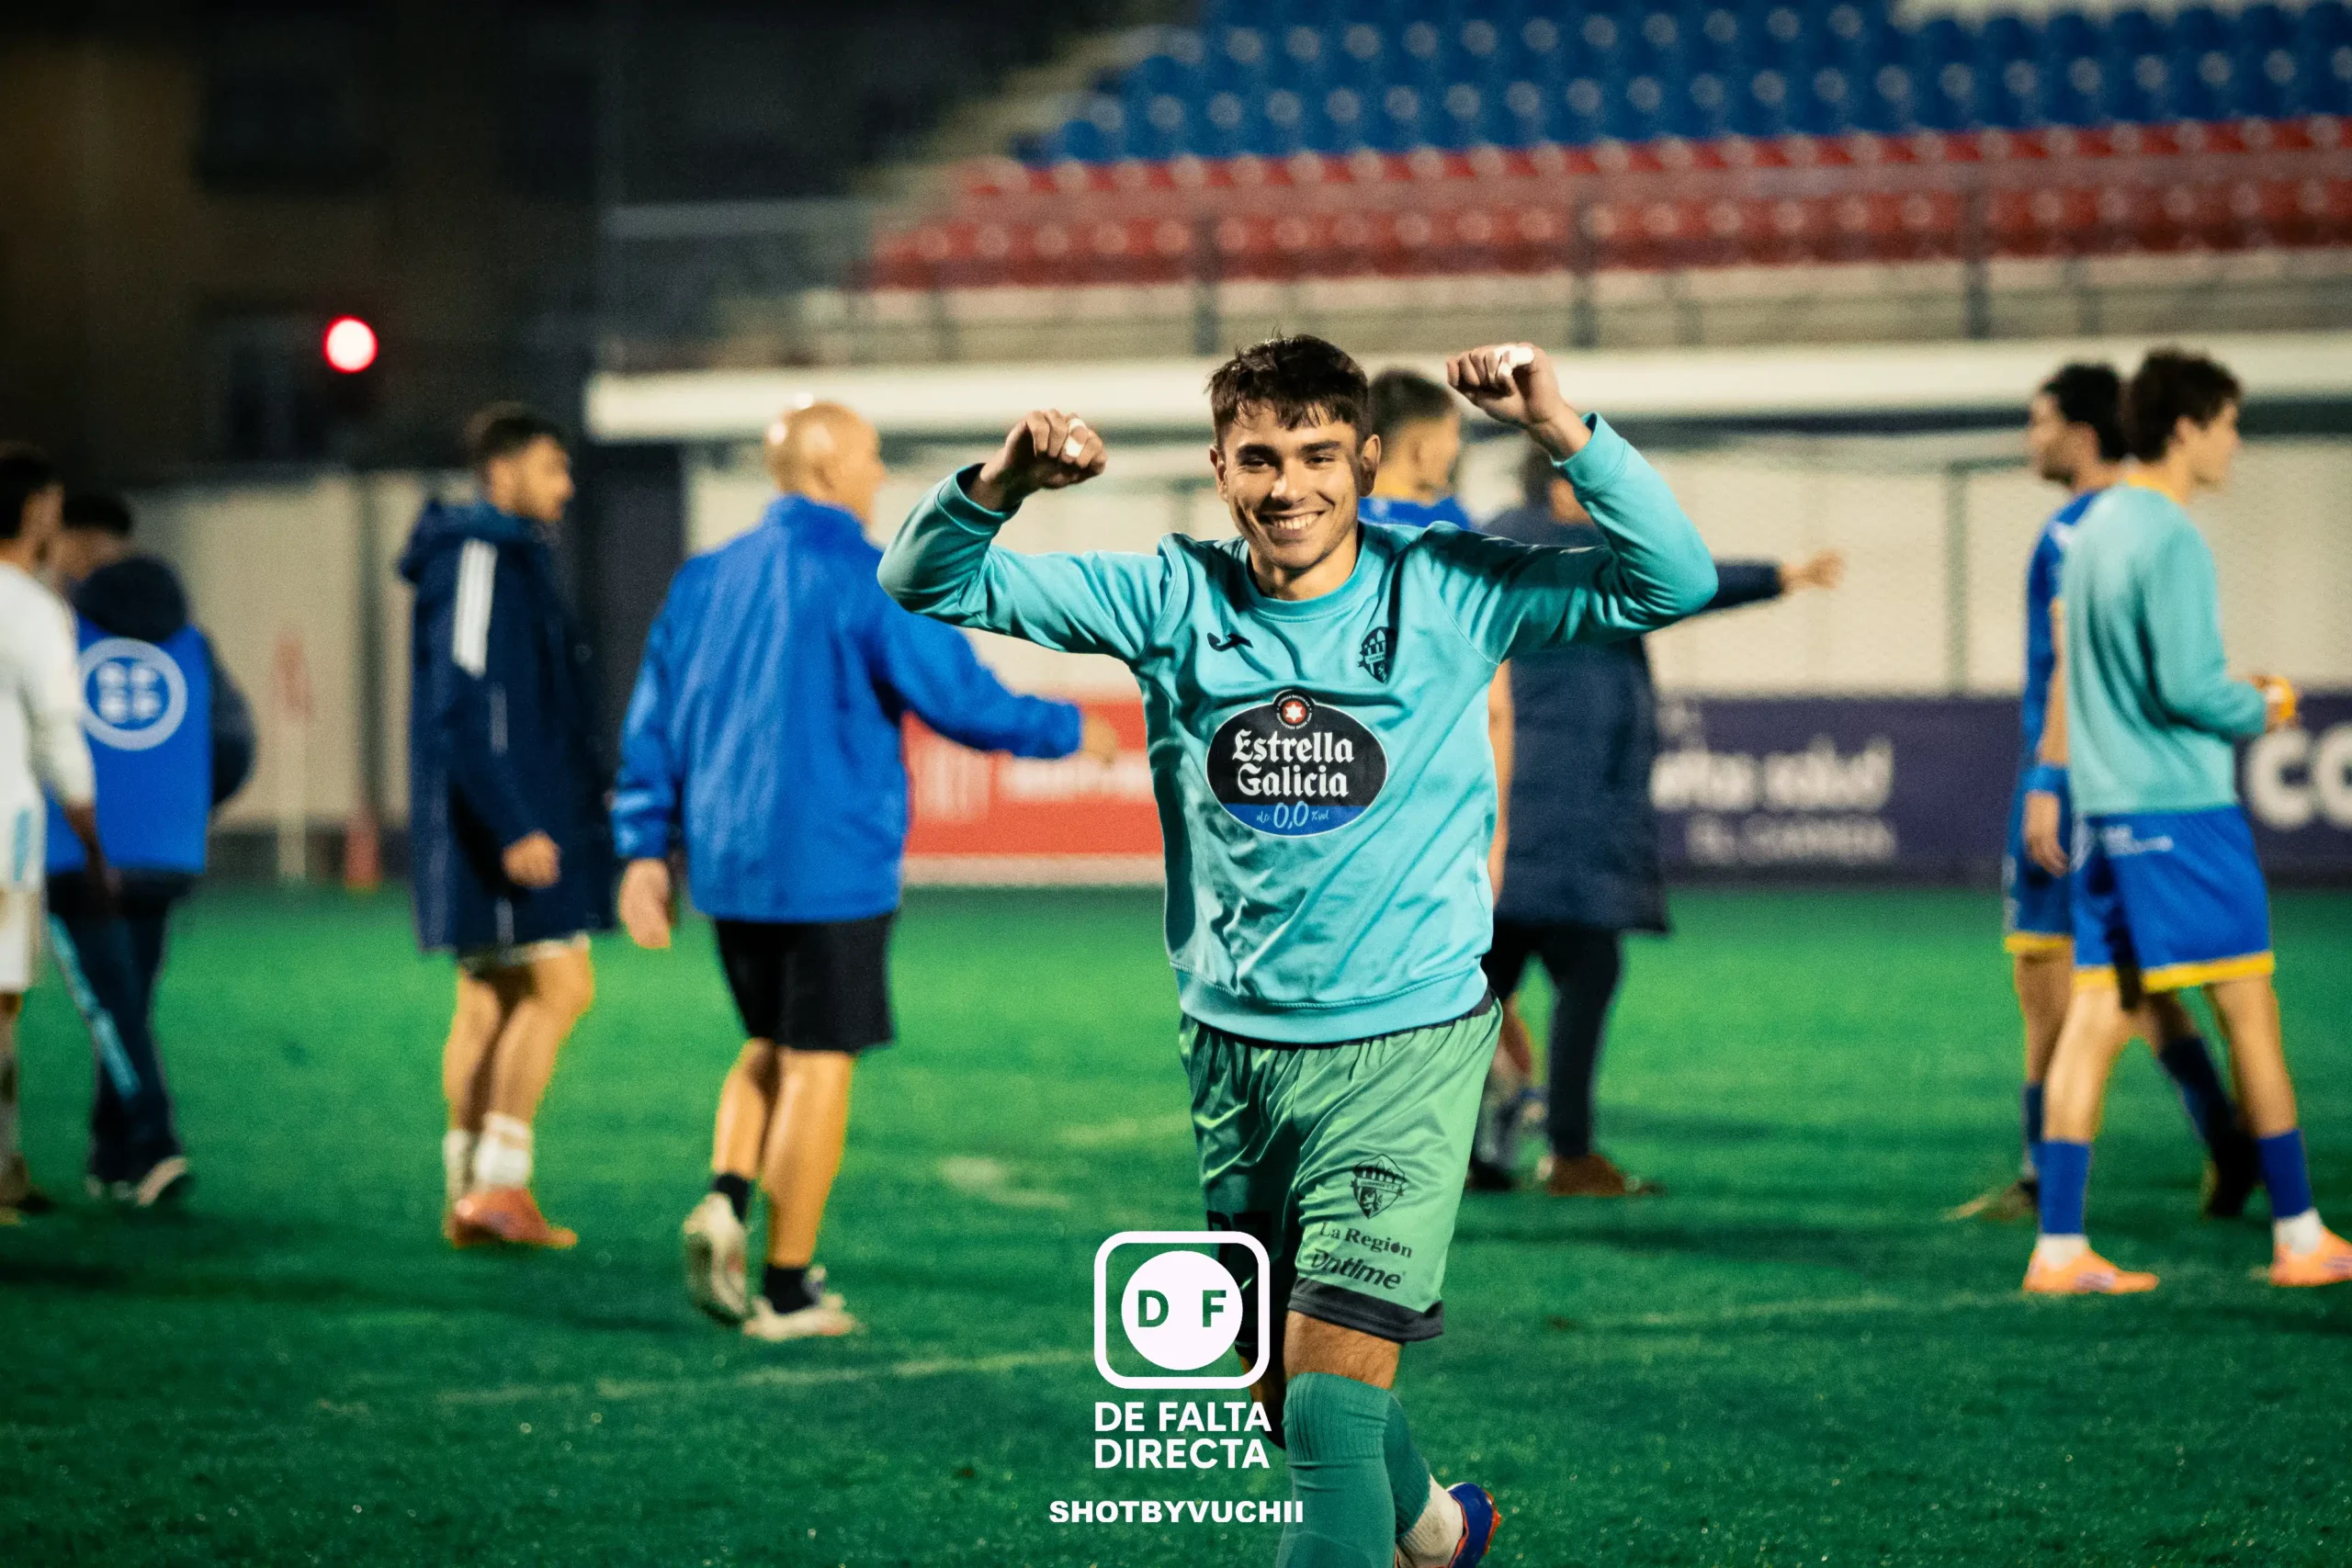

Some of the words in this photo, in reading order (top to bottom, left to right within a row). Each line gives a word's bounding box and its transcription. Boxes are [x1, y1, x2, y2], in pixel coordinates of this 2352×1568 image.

[1232, 728, 1355, 763] Estrella
[1238, 763, 1350, 797] Galicia
[1273, 800, 1309, 829] 0,0
[1319, 1222, 1340, 1240] La
